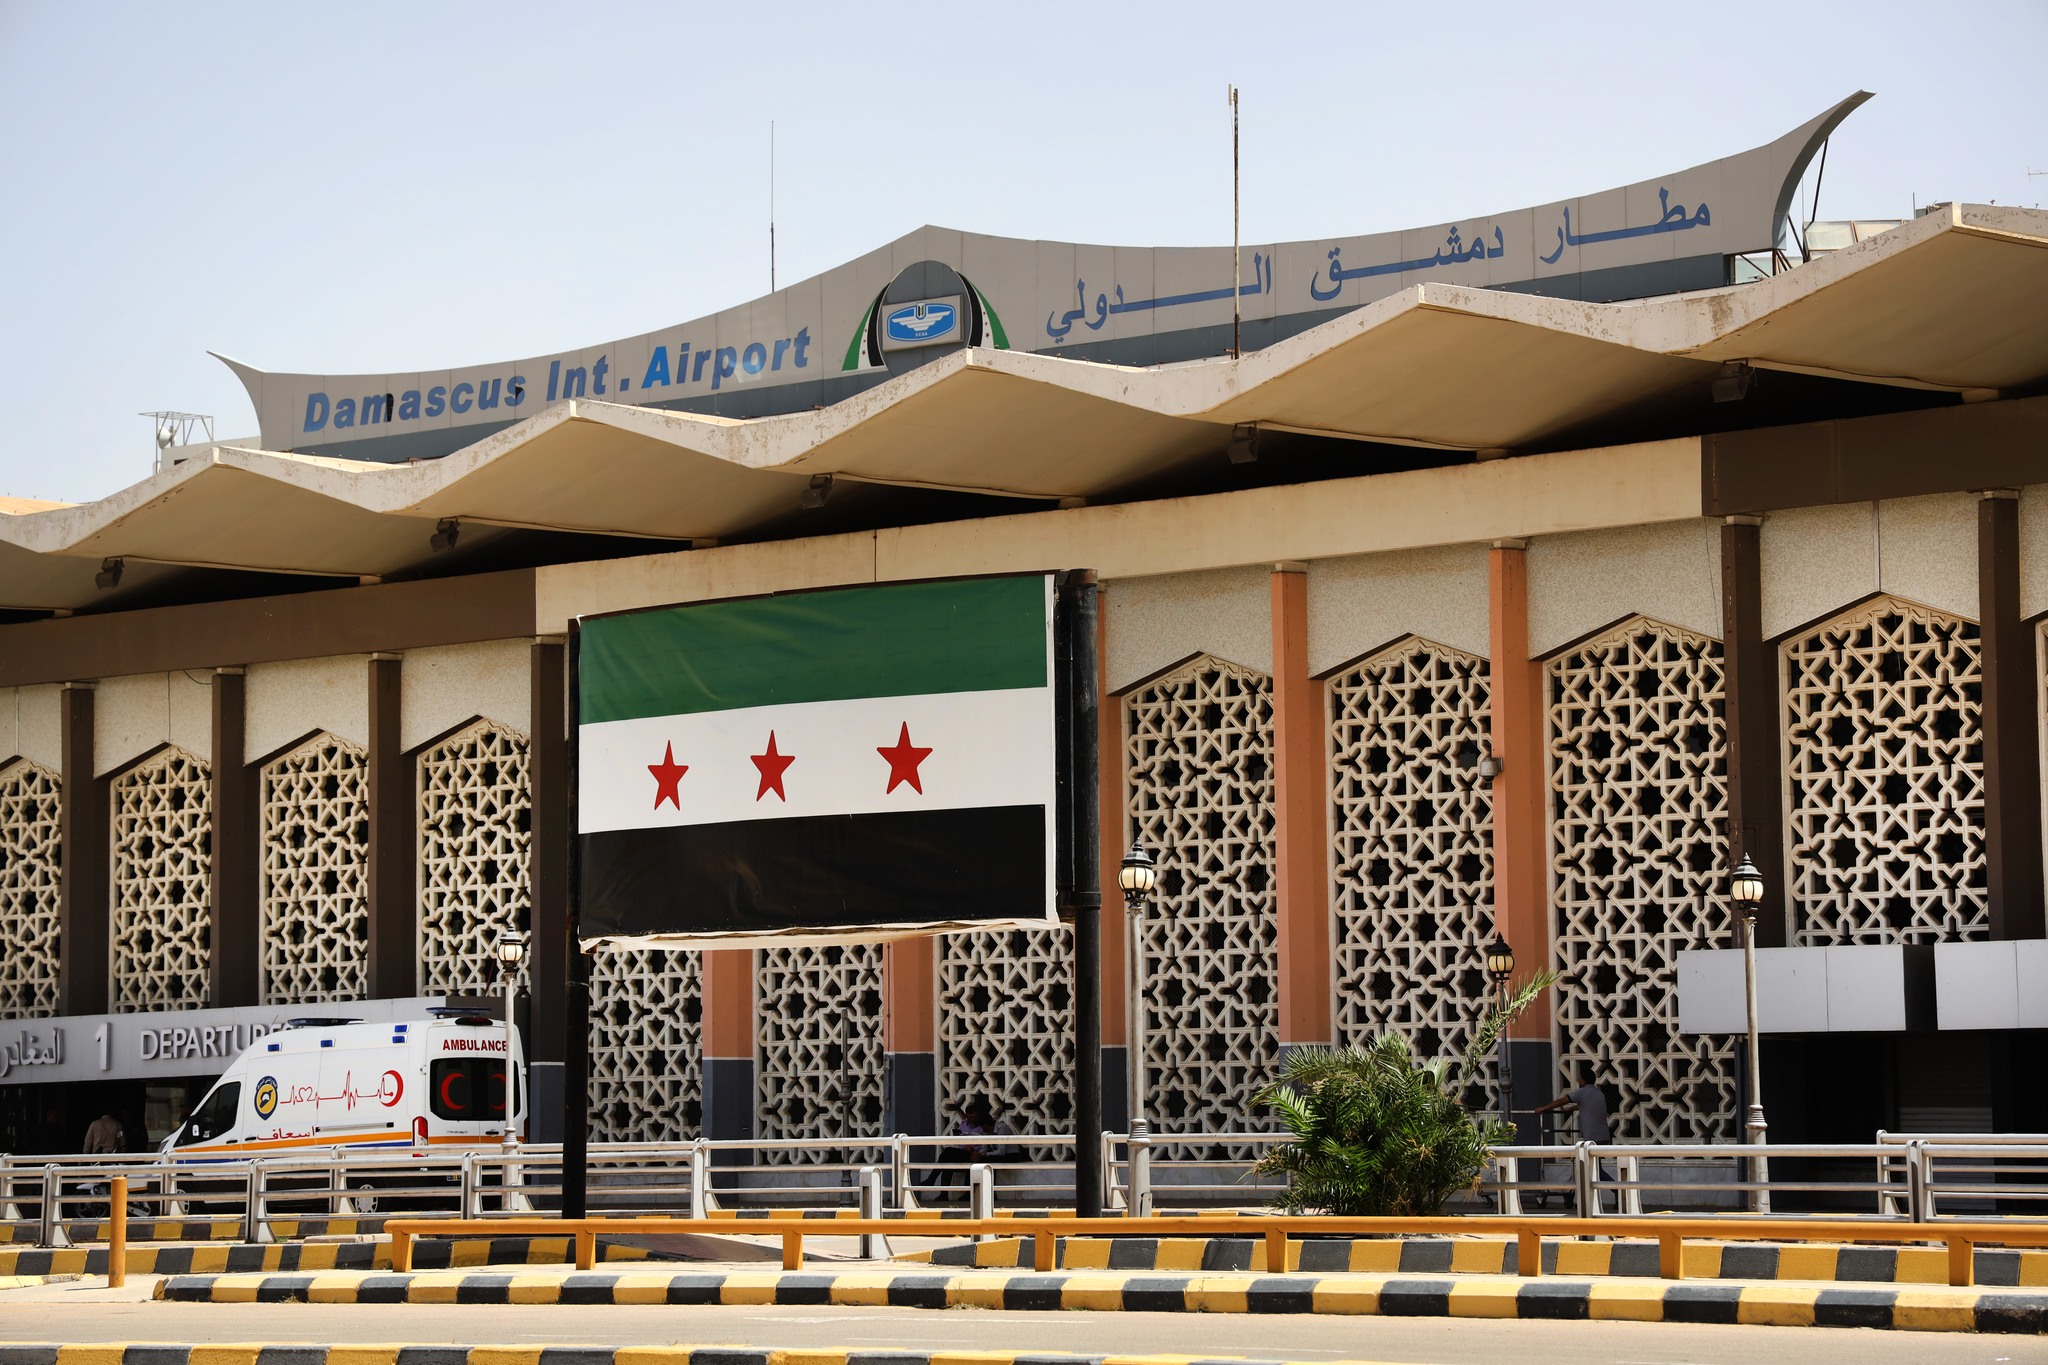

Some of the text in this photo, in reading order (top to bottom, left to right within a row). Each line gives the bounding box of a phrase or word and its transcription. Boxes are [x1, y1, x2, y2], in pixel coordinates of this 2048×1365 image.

[1046, 187, 1711, 344] مطار دمشق الدولي
[303, 376, 526, 433] Damascus
[641, 326, 811, 390] Airport
[95, 1022, 112, 1071] 1
[443, 1039, 506, 1052] AMBULANCE
